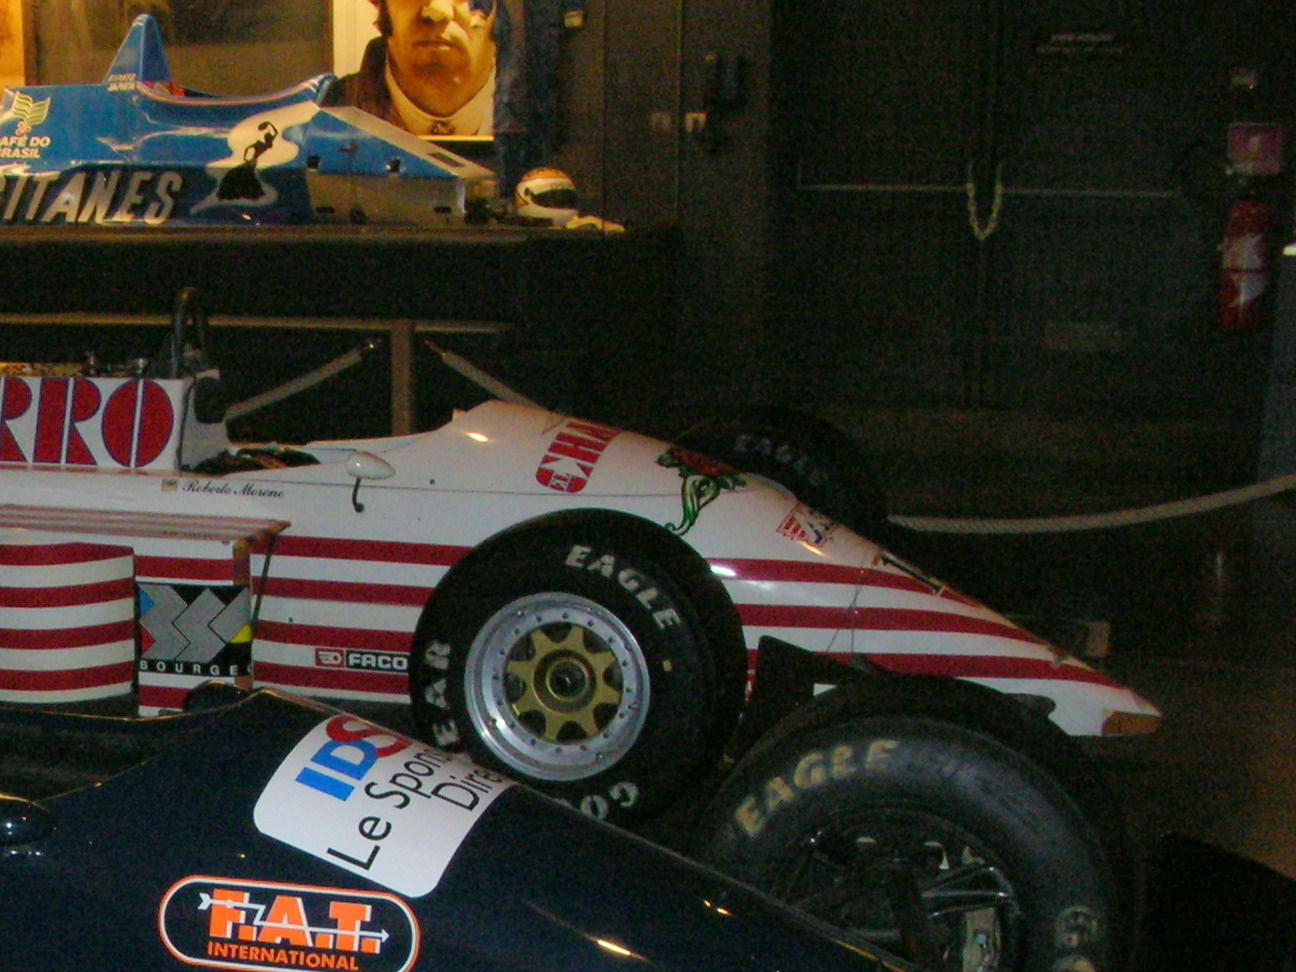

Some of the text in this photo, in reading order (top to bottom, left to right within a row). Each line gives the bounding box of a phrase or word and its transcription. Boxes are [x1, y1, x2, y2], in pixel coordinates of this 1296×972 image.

[29, 136, 51, 147] DO
[182, 479, 231, 495] Roberto
[565, 544, 681, 630] EAGLE
[348, 653, 408, 671] FACO
[424, 640, 460, 748] EAR
[734, 738, 901, 839] EAGLE
[326, 814, 392, 871] Le
[207, 941, 360, 972] INTERNATIONAL
